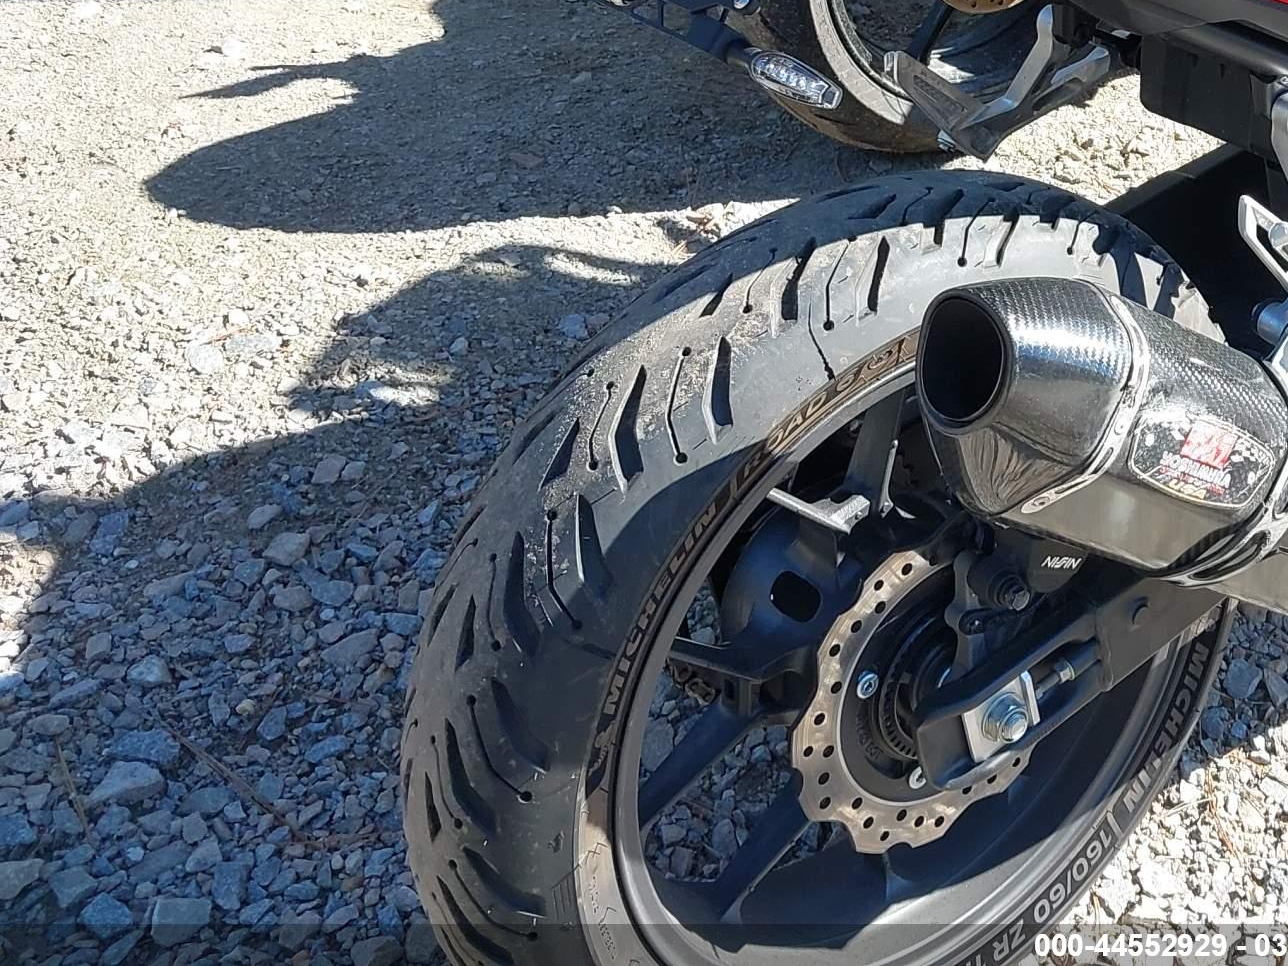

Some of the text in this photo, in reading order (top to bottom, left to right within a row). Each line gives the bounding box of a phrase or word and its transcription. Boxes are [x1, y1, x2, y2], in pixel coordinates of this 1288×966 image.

[605, 504, 718, 716] MICHELIN
[741, 394, 829, 480] ROAD
[1040, 555, 1083, 570] NISSIN
[1121, 640, 1212, 814] MICHELIN
[1033, 828, 1115, 924] 160/60
[992, 917, 1026, 962] ZR
